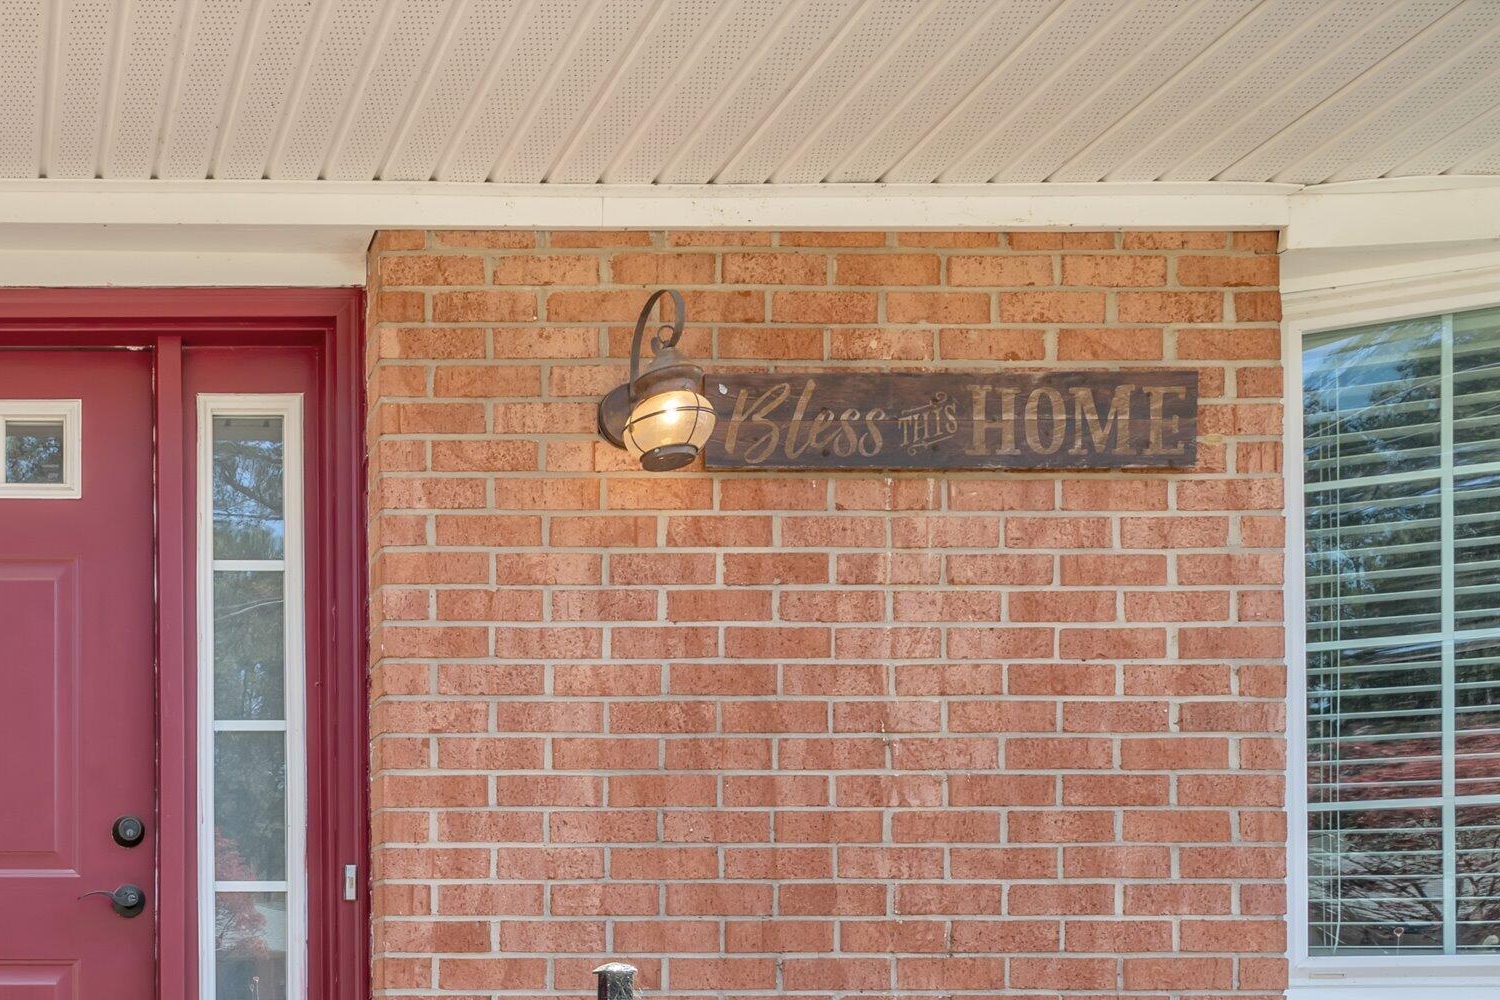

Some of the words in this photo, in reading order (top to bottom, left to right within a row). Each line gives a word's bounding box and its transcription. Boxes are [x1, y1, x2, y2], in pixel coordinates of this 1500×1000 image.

[724, 378, 886, 464] Bless
[898, 401, 959, 448] THIS
[964, 383, 1187, 456] HOME
